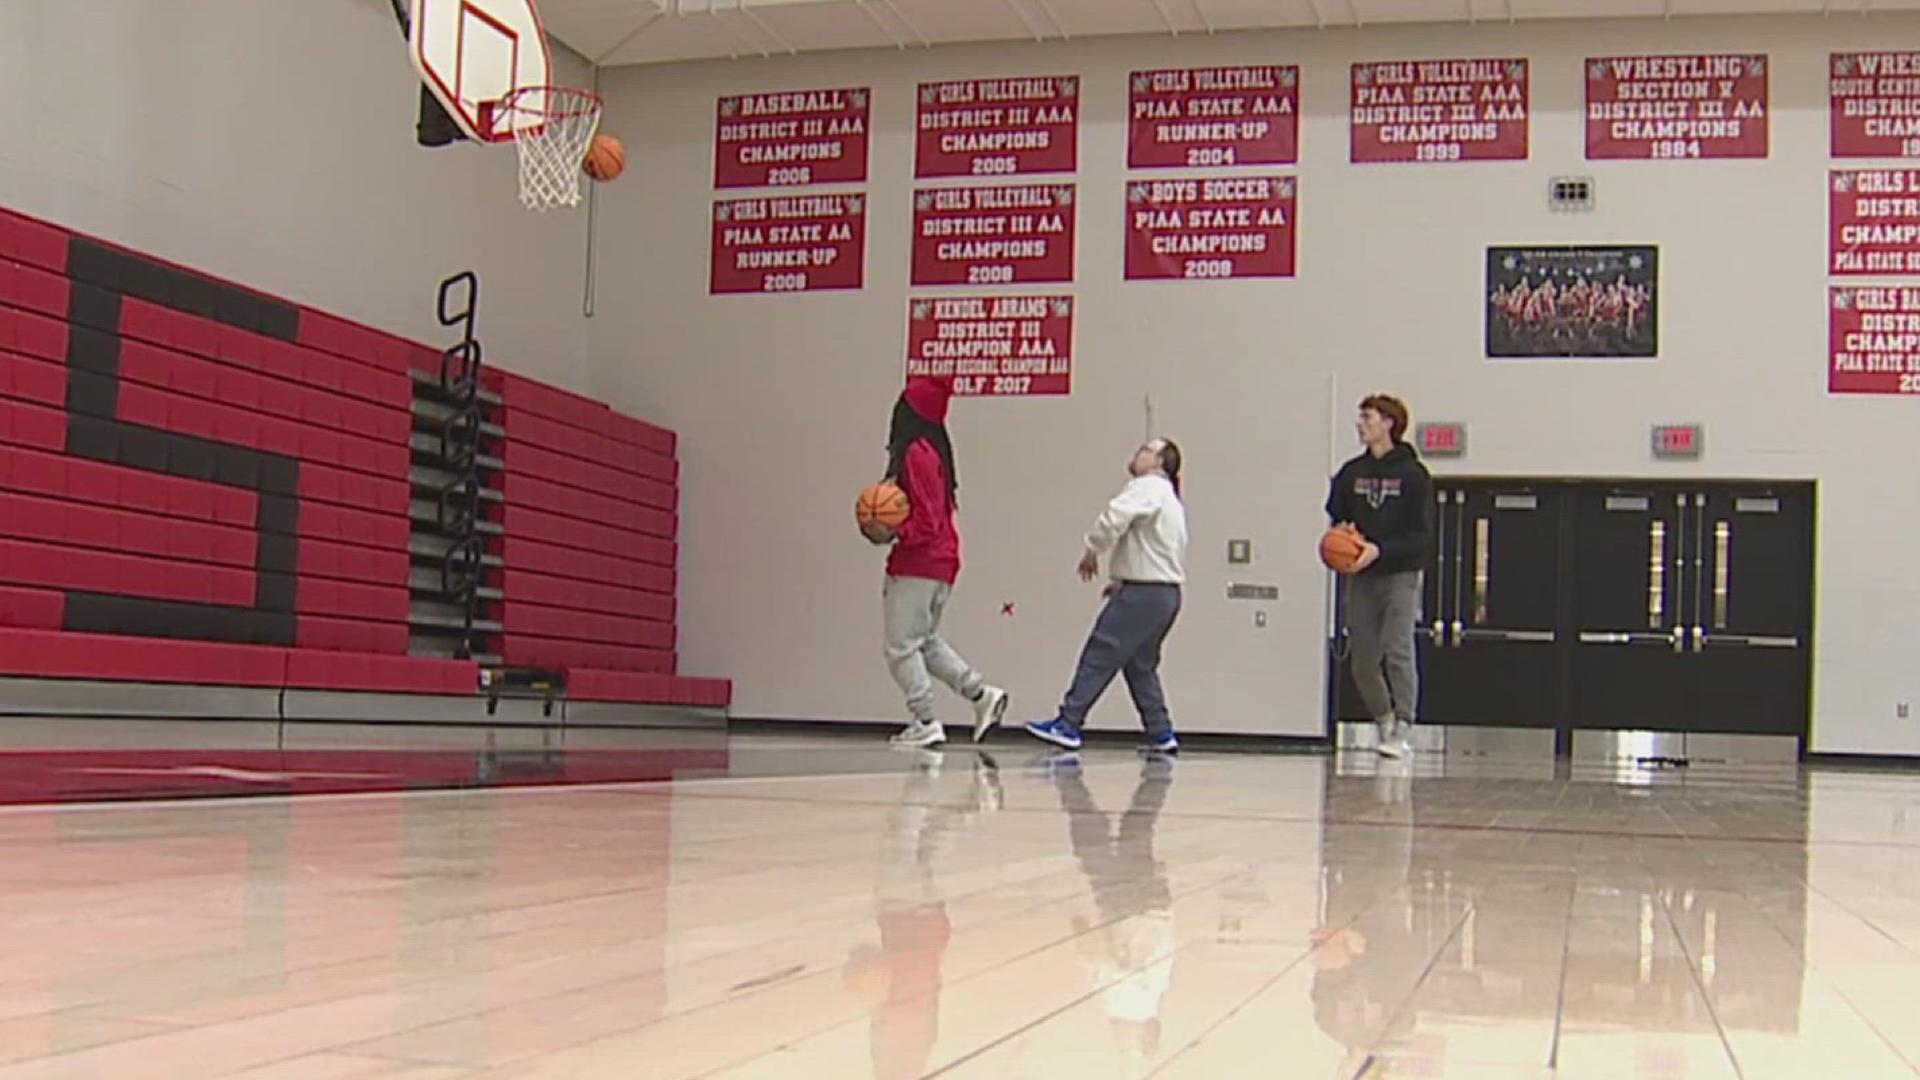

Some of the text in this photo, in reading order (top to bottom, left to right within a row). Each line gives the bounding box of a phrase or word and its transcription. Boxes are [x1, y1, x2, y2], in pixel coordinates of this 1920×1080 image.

[1152, 68, 1274, 91] GIRLS VOLLEYBALL
[1376, 61, 1503, 84] GIRLS VOLLEYBALL
[1612, 58, 1742, 80] WRESTLING
[939, 79, 1055, 103] GIRLS VOLLEYBALL
[1358, 83, 1521, 104] PIAA STATE AAA
[1618, 81, 1708, 99] SECTION
[741, 92, 845, 115] BASEBALL
[1135, 96, 1291, 119] PIAA STATE AAA
[1353, 103, 1525, 124] DISTRICT III AAA
[1590, 99, 1763, 119] DISTRICT III AA
[921, 106, 1073, 129] DISTRICT III AAA
[720, 117, 863, 141] DISTRICT III AAA
[1157, 122, 1268, 142] RUNNER-UP
[1380, 123, 1497, 142] CHAMPIONS
[1612, 120, 1740, 138] CHAMPIONS
[941, 131, 1049, 152] CHAMPIONS
[740, 142, 841, 163] CHAMPIONS
[1188, 147, 1234, 165] 2004
[972, 157, 1017, 174] 2005
[1152, 180, 1269, 201] BOYS SOCCER
[1857, 171, 1904, 193] GIRLS
[734, 197, 843, 220] GIRLS VOLLEYBALL
[935, 187, 1052, 210] GIRLS VOLLEYBALL
[922, 214, 1063, 236] DISTRICT III AA
[1135, 208, 1285, 228] PIAA STATE AA
[724, 223, 851, 246] PIAA STATE AA
[1152, 234, 1266, 253] CHAMPIONS
[736, 248, 837, 268] RUNNER-UP
[937, 240, 1046, 260] CHAMPIONS
[1835, 251, 1864, 271] PIAA
[1866, 251, 1904, 271] STATE
[1857, 289, 1897, 311] GIRLS
[938, 320, 1041, 338] DISTRICT III
[922, 338, 1056, 357] CHAMPION AAA
[1835, 352, 1864, 371] PIAA
[1866, 352, 1904, 372] STATE
[953, 376, 1032, 393] OLF 2017
